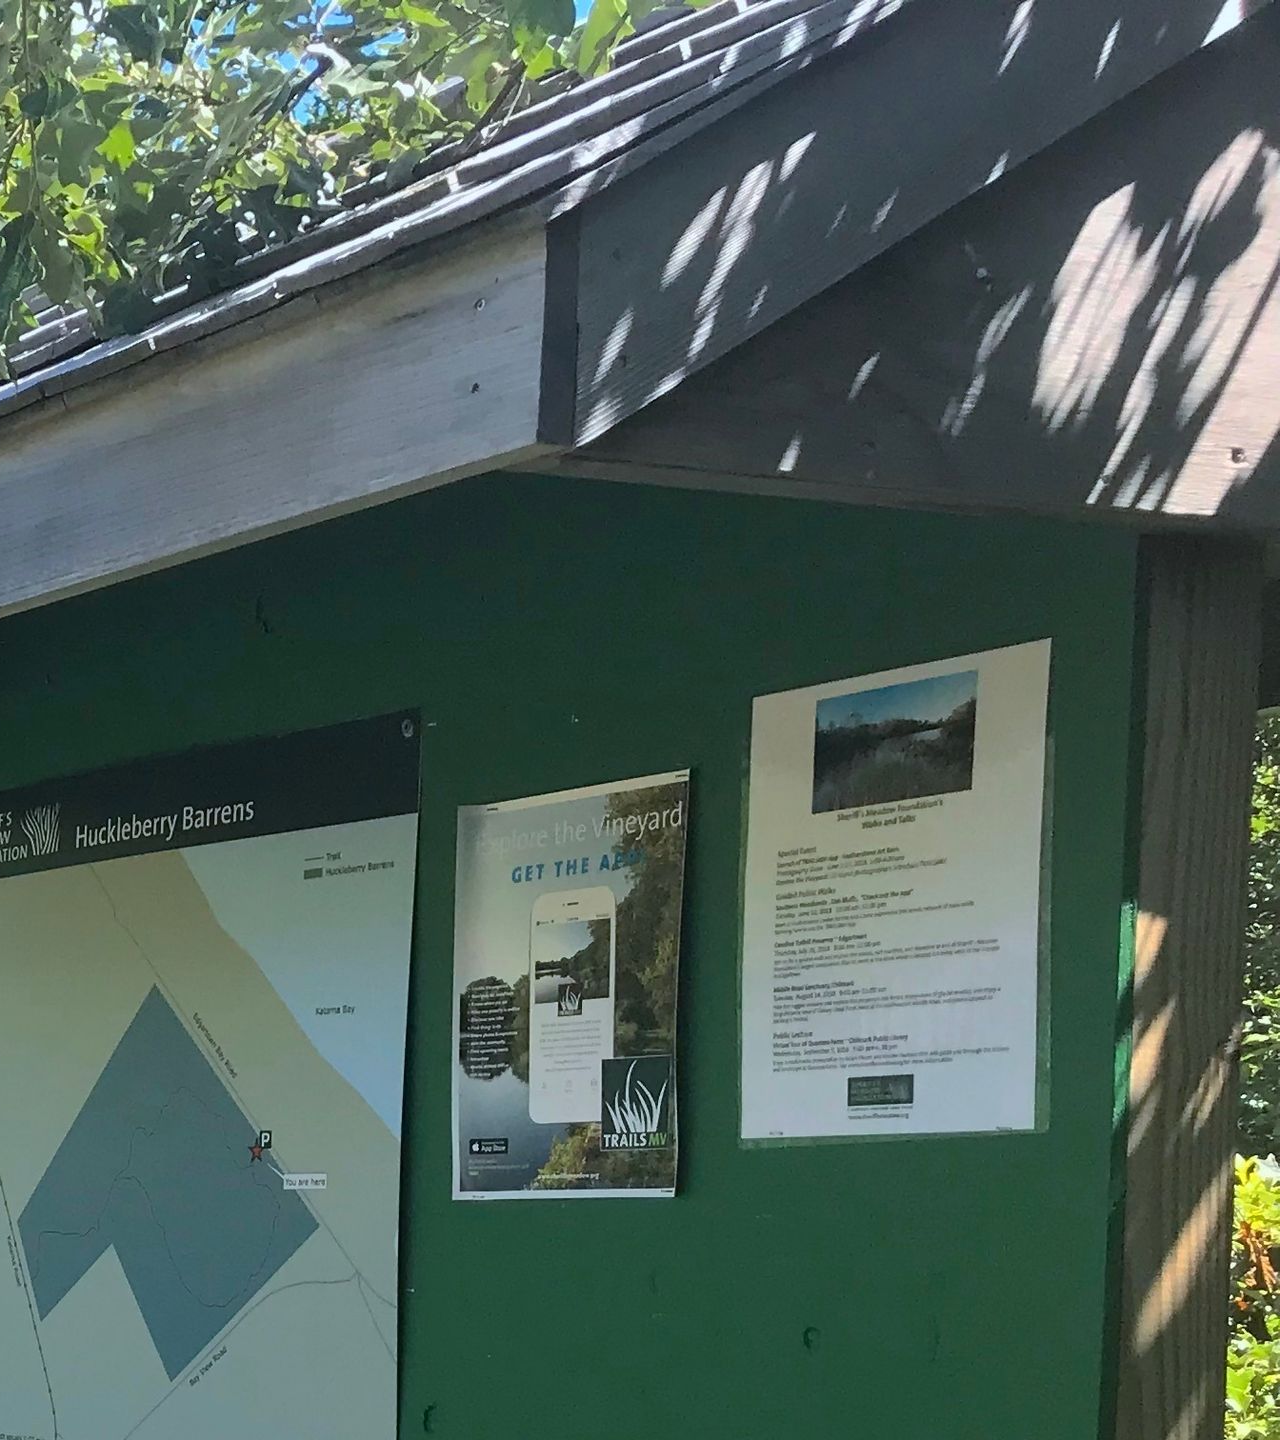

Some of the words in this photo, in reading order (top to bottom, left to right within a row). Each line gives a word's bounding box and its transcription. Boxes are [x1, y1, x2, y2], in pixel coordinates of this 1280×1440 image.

[75, 812, 178, 848] Huckleberry
[182, 800, 255, 831] Barrens
[555, 819, 586, 846] the
[592, 800, 683, 841] Vineyard
[512, 863, 545, 884] GET
[554, 857, 589, 878] THE
[261, 1132, 270, 1148] P
[481, 1144, 492, 1152] App
[603, 1133, 648, 1148] TRAILS
[648, 1132, 667, 1147] MV
[285, 1179, 297, 1187] You
[311, 1178, 326, 1187] here
